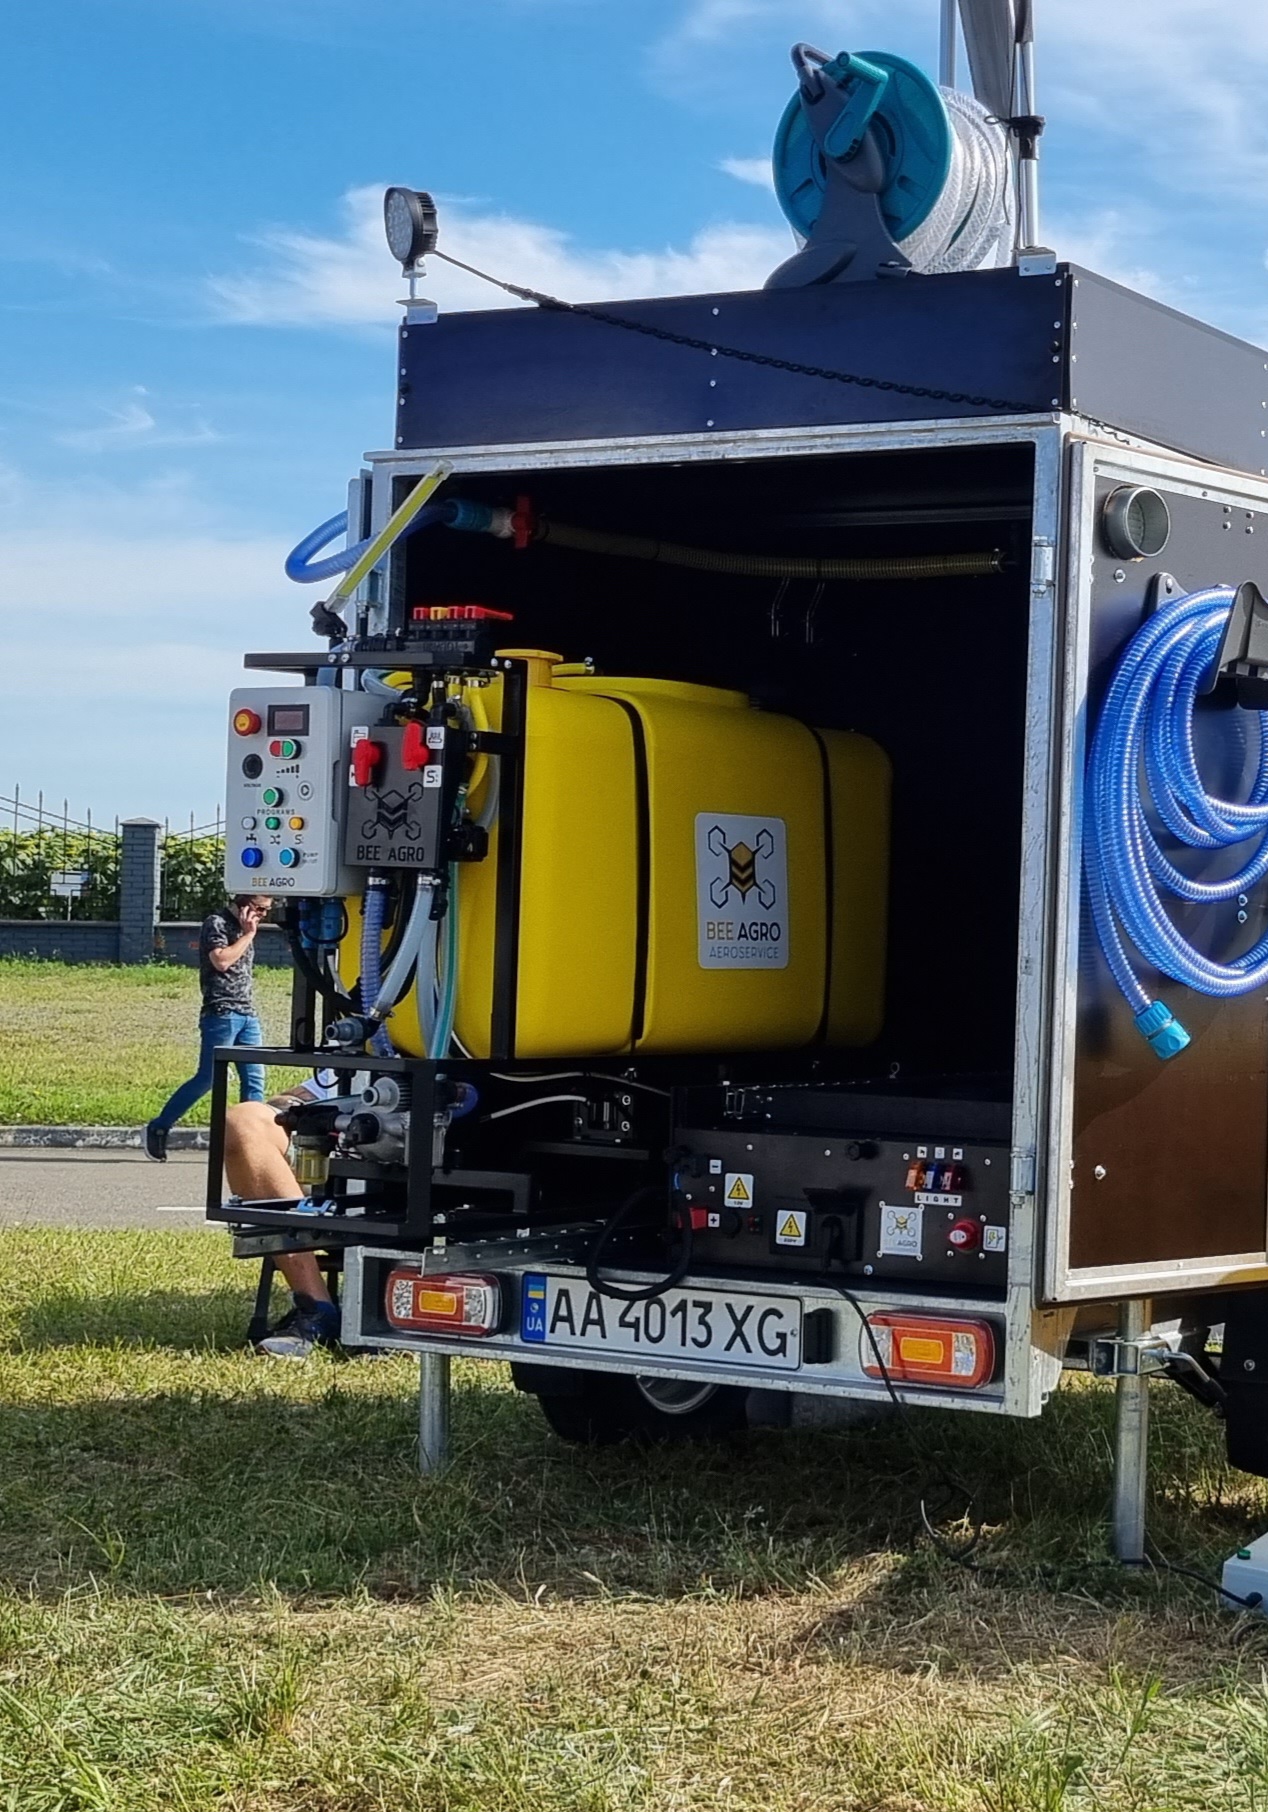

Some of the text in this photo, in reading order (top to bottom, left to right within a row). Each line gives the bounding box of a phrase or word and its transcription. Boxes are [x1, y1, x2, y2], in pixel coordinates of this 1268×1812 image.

[356, 844, 425, 863] BEE AGRO
[251, 877, 296, 888] BEE AGRO
[706, 921, 781, 942] BEE AGRO
[709, 946, 779, 959] AEROSERVICE
[526, 1316, 544, 1333] UA
[549, 1288, 789, 1358] AA 4013 XG
